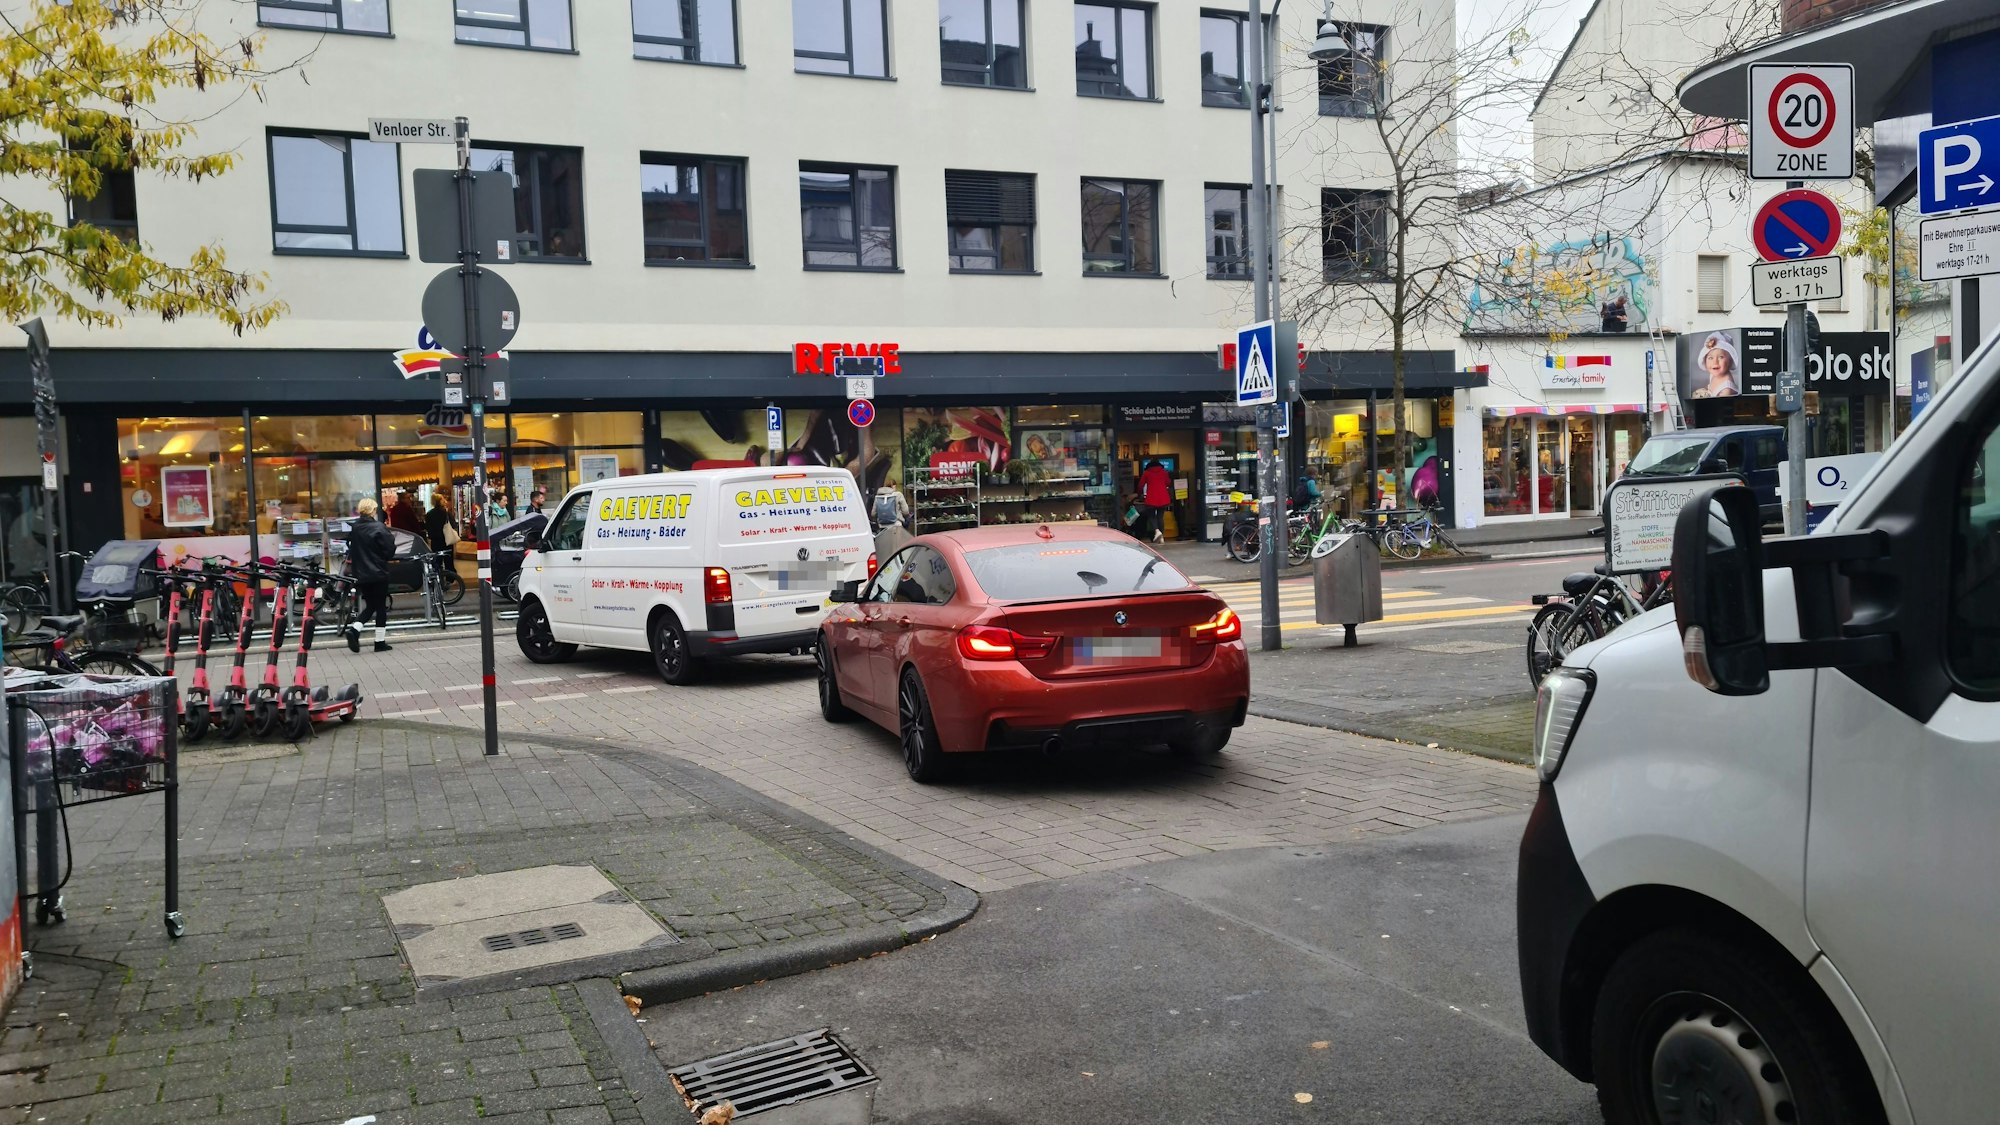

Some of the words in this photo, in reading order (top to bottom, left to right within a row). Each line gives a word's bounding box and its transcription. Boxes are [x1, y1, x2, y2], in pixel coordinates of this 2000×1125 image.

[1784, 93, 1822, 128] 20
[374, 122, 423, 137] Venloer
[427, 122, 451, 137] Str.
[1777, 154, 1828, 172] ZONE
[1934, 134, 1982, 202] P
[1923, 232, 1934, 242] mit
[1949, 243, 1964, 253] Ehre
[1936, 258, 1965, 270] werktags
[1966, 255, 1983, 266] 17-21
[1985, 254, 1990, 264] h
[1767, 262, 1828, 281] werktags
[1773, 286, 1782, 299] 8
[1794, 284, 1811, 297] 17
[1815, 282, 1823, 295] h
[1582, 373, 1605, 384] family
[426, 404, 464, 427] dm
[1145, 406, 1156, 414] dat
[1156, 406, 1165, 414] De
[1166, 406, 1175, 414] Do
[770, 411, 777, 430] P
[1817, 466, 1848, 490] O2
[735, 485, 845, 507] GAEVERT
[599, 493, 692, 521] GAEVERT
[769, 507, 811, 517] Heizung
[820, 505, 847, 513] Bäder
[597, 528, 610, 538] Gas
[617, 527, 651, 541] Heizung
[659, 526, 686, 537] Bäder
[793, 524, 817, 532] Wärme
[822, 522, 851, 530] Kopplung
[591, 579, 605, 588] Solar
[611, 579, 625, 588] Kraft
[629, 579, 649, 589] Wärme
[654, 580, 683, 593] Kopplung
